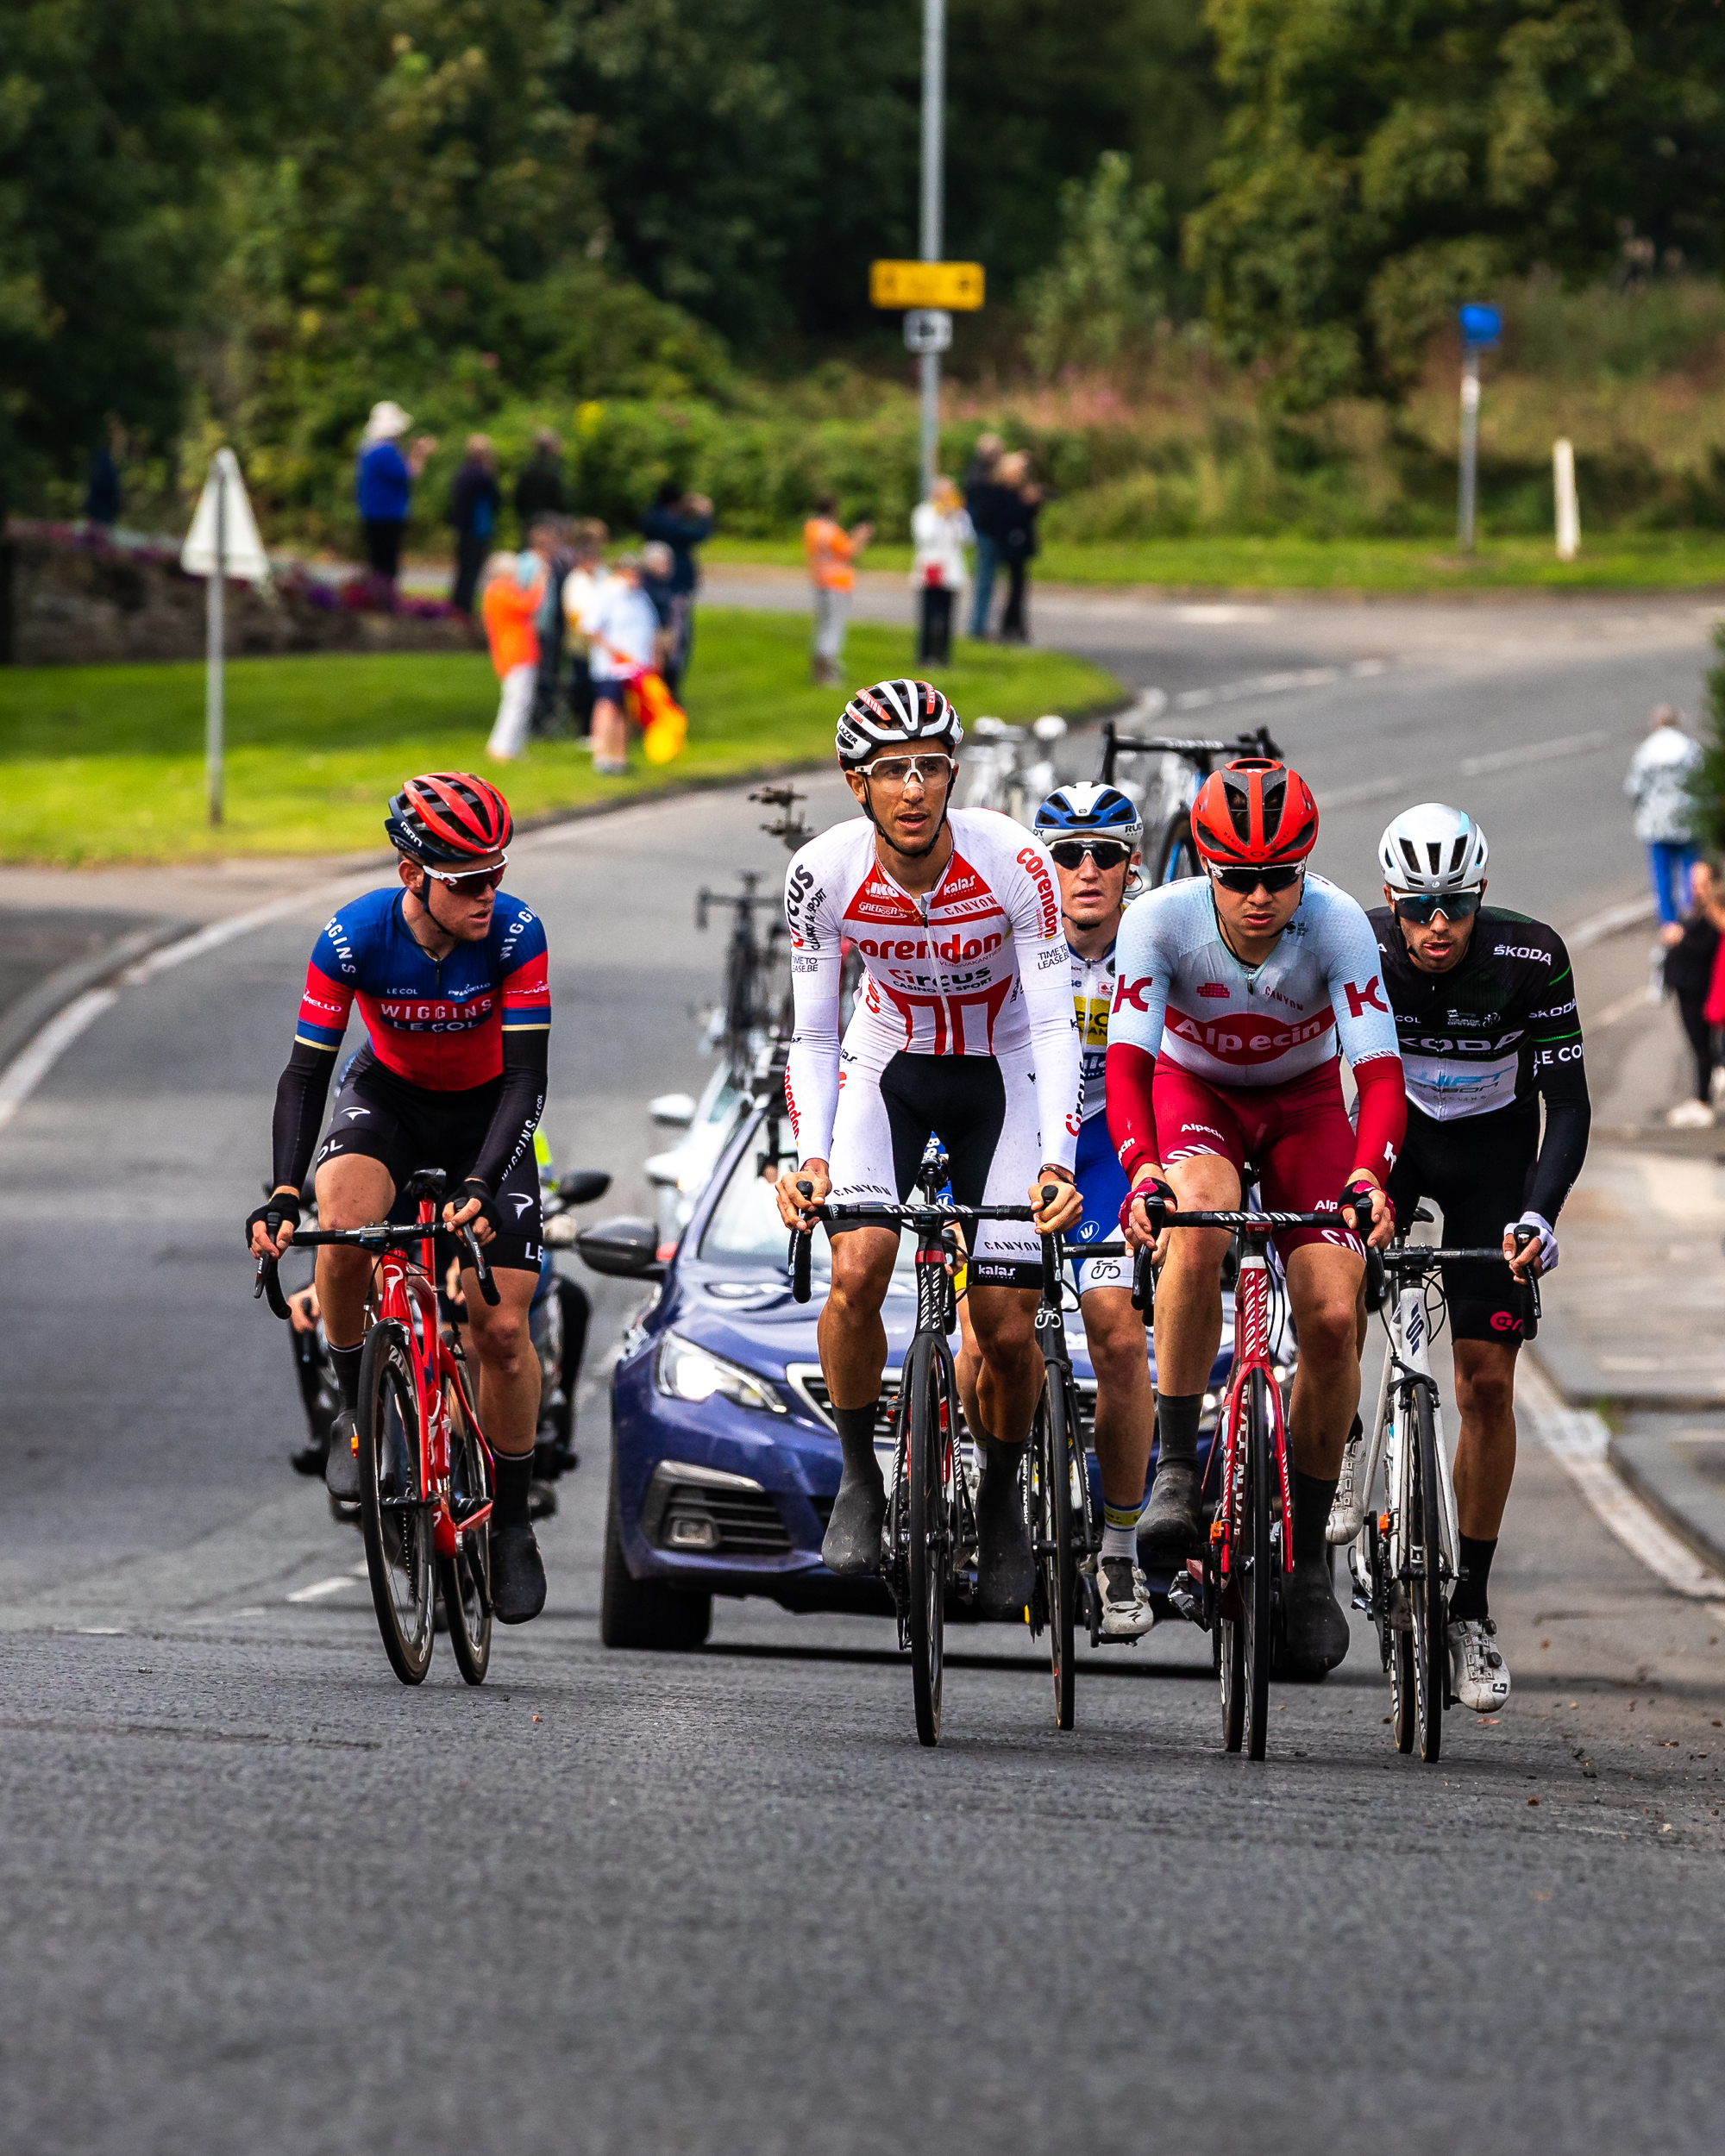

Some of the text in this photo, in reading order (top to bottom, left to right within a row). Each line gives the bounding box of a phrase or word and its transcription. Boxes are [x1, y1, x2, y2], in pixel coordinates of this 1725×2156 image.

[838, 724, 858, 745] LAZER
[400, 821, 423, 848] GIRO
[943, 874, 975, 896] kalas
[1016, 847, 1058, 938] corendon
[944, 895, 998, 916] CANYON
[1493, 943, 1552, 966] ŠKODA
[955, 975, 993, 993] SPORT
[380, 999, 492, 1019] WIGGINS
[1264, 986, 1304, 1012] CANYON
[393, 1020, 480, 1033] LE COL
[1395, 1015, 1421, 1024] COL
[1174, 1018, 1321, 1053] Alpecin
[1181, 1123, 1225, 1142] Alpecin
[501, 1119, 536, 1181] WIGGINS
[833, 1184, 893, 1197] CANYON
[983, 1241, 1041, 1251] CANYON
[978, 1264, 1016, 1277] kalas
[1245, 1270, 1257, 1358] CANYON
[1258, 1273, 1269, 1357] CANYON
